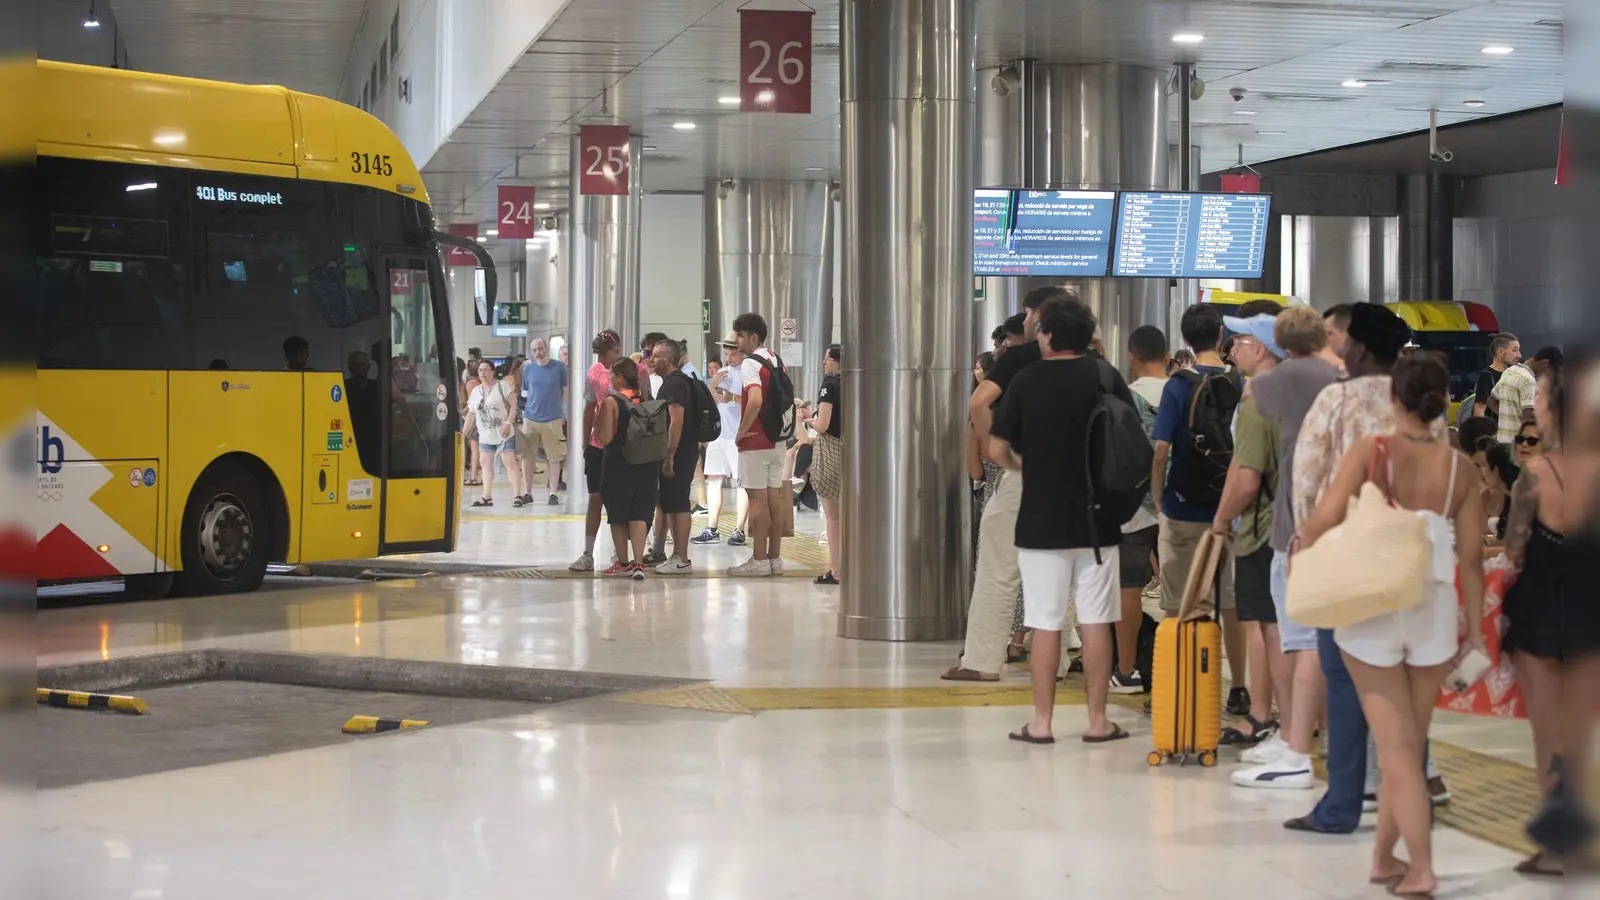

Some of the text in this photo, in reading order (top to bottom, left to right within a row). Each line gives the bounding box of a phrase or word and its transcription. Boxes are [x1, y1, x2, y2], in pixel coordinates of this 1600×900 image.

[748, 40, 804, 85] 26
[351, 151, 392, 177] 3145
[586, 145, 624, 176] 25
[196, 186, 282, 205] 401 Bus complet
[501, 201, 531, 224] 24
[393, 273, 409, 287] 21
